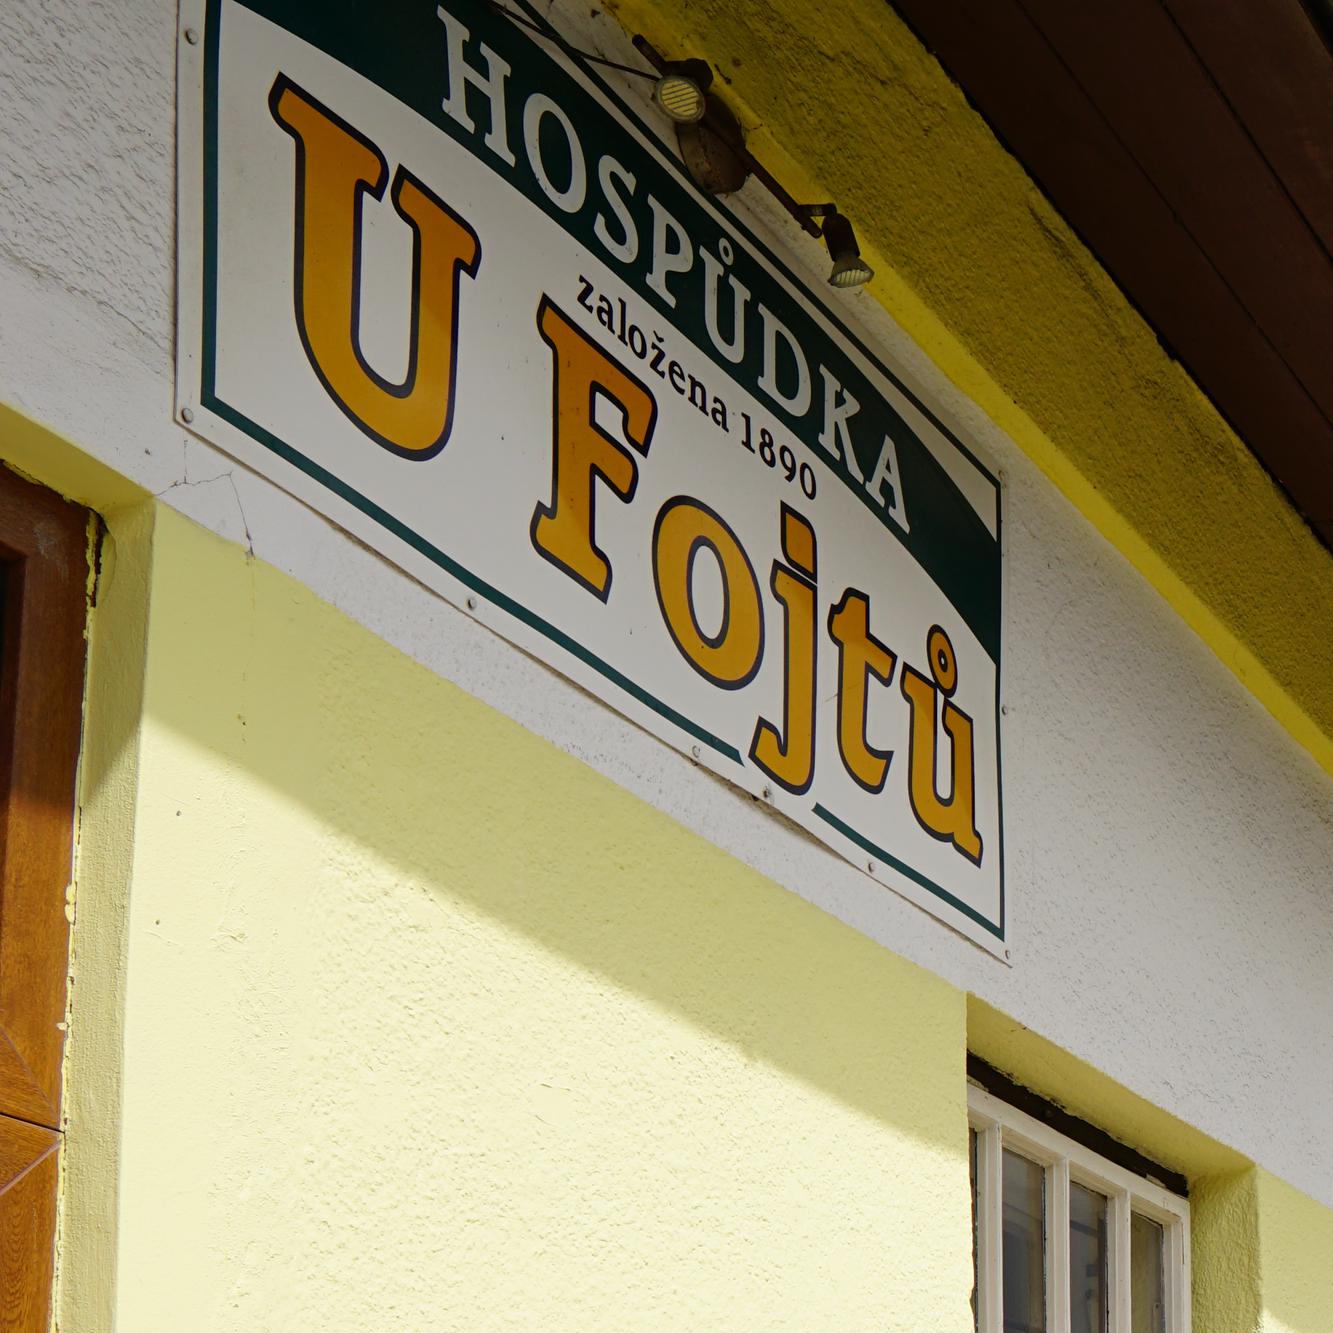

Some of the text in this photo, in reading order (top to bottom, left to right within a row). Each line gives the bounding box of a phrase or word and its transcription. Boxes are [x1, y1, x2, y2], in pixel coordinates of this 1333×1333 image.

[267, 71, 984, 868] U Fojtů
[437, 3, 911, 535] HOSPŮDKA
[575, 273, 818, 502] založena 1890
